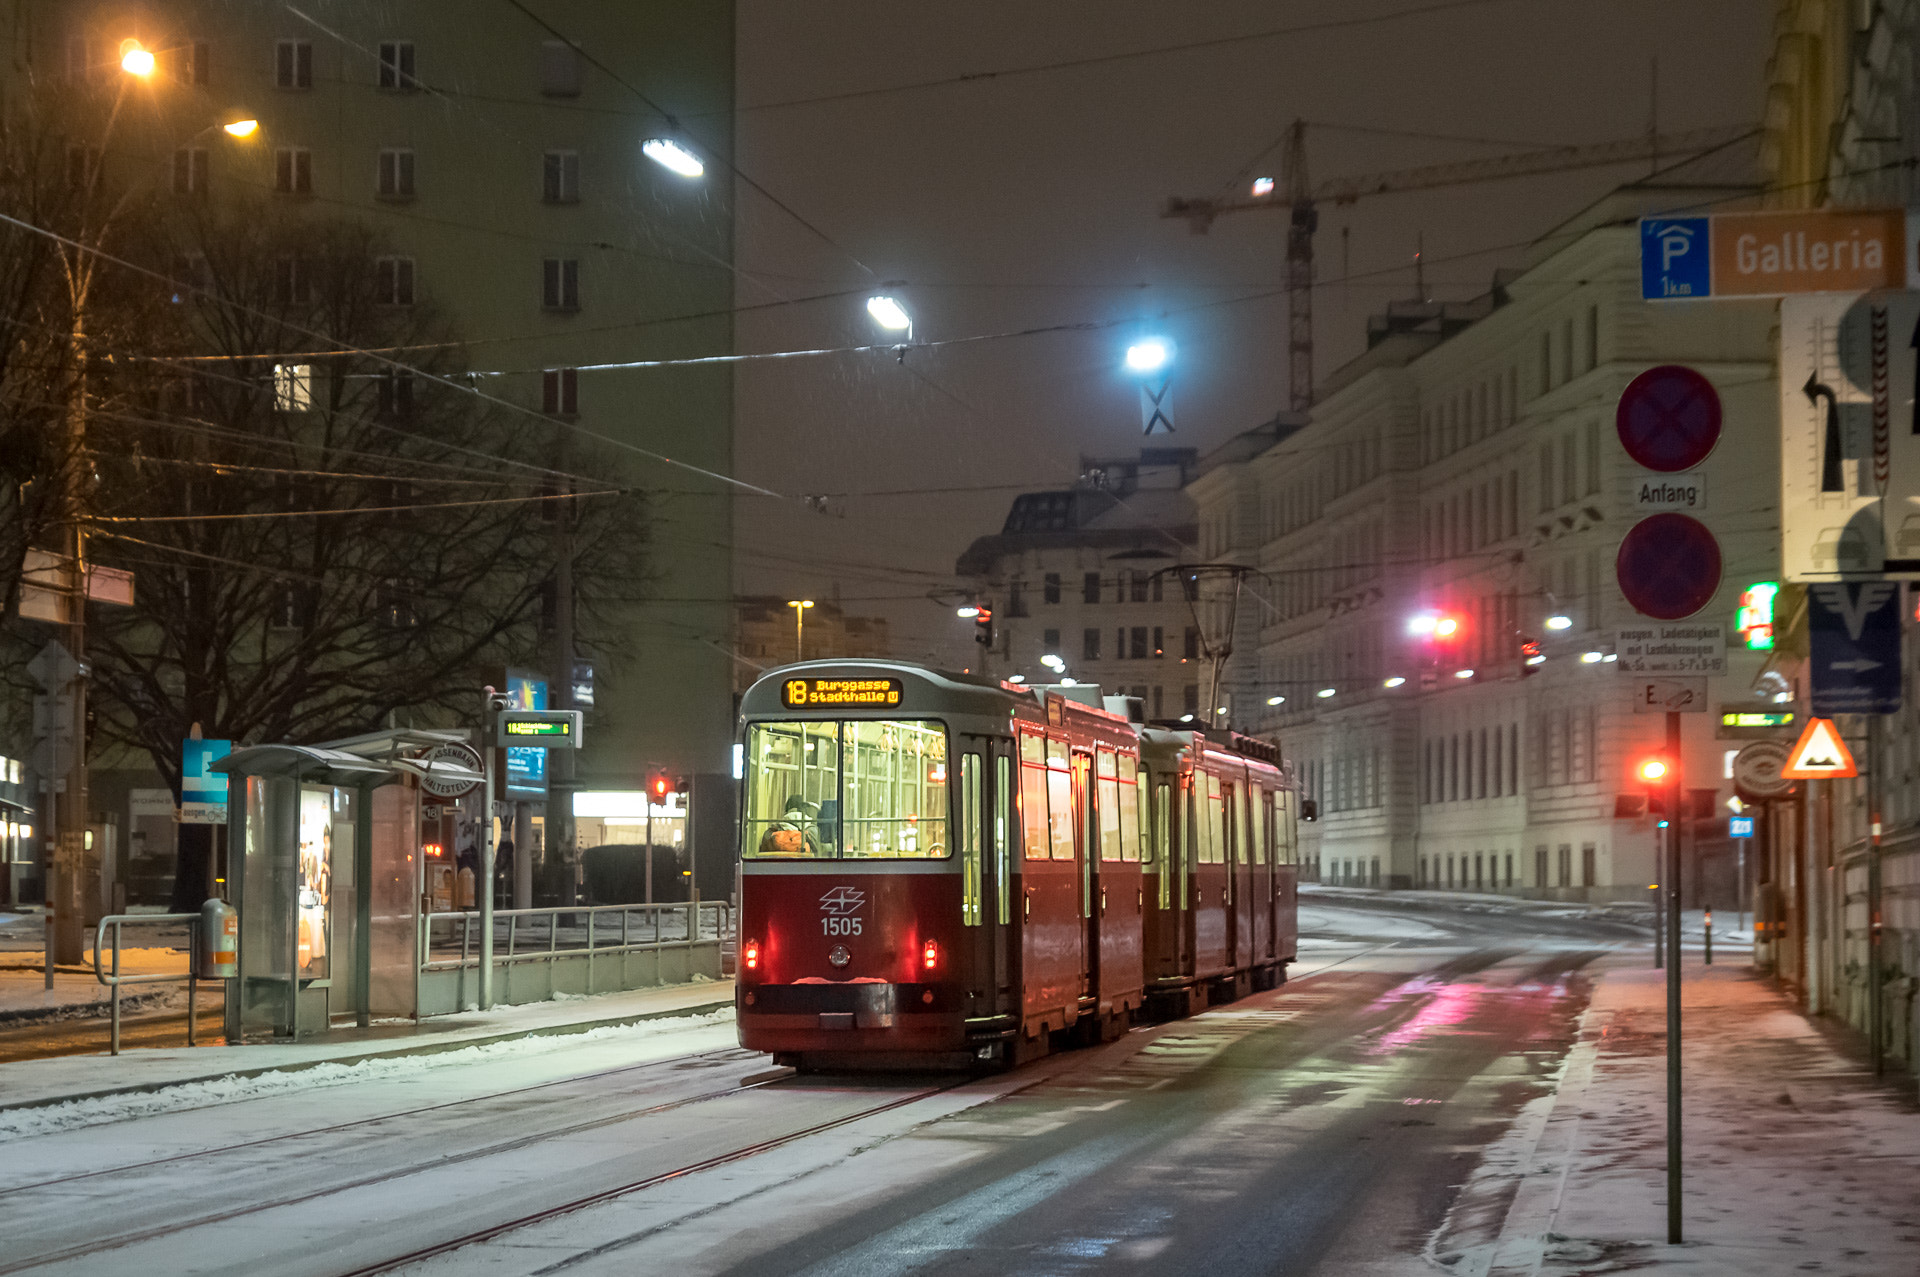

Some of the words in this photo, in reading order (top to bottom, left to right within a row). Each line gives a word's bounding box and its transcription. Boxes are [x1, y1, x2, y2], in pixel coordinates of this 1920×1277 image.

[1736, 230, 1883, 274] Galleria
[1640, 482, 1697, 506] Anfang
[787, 680, 807, 704] 18
[816, 680, 891, 692] Burggasse
[809, 691, 886, 704] Stadthalle
[562, 723, 569, 734] 6
[425, 749, 476, 768] ASSENBAHN
[424, 776, 473, 793] HALTESTELLE
[427, 808, 437, 817] 18
[821, 917, 863, 936] 1505
